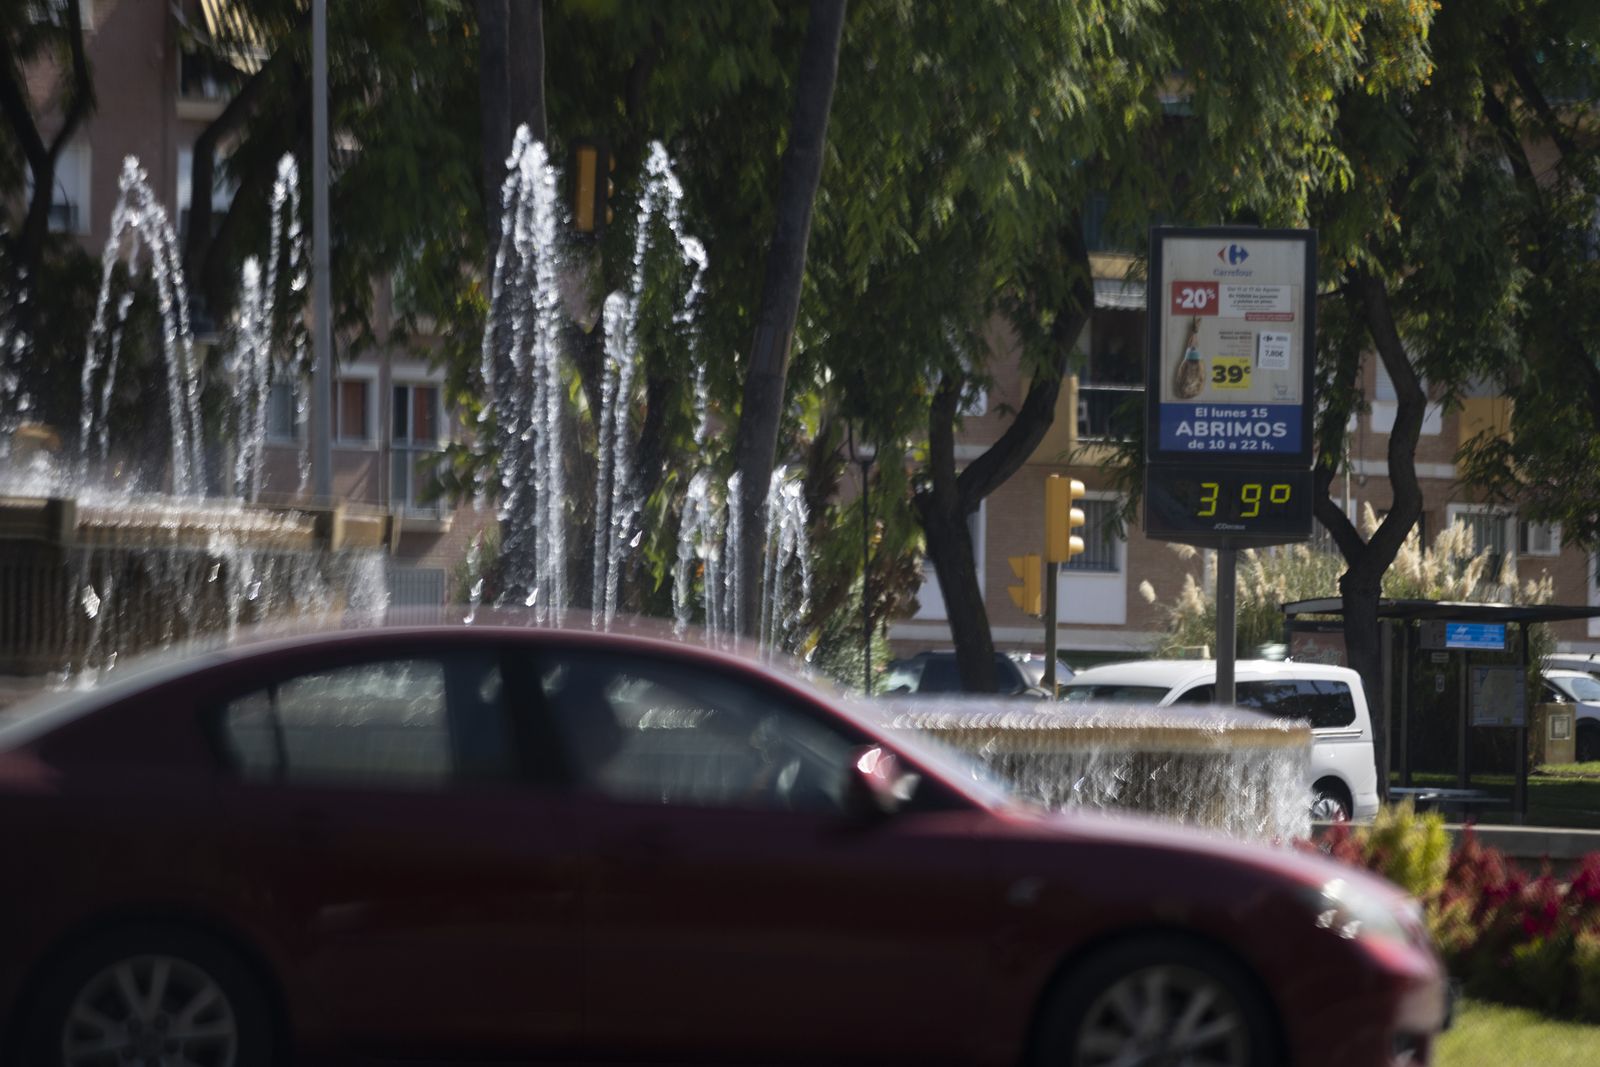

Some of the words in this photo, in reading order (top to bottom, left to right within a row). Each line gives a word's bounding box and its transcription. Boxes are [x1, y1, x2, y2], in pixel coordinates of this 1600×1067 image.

[1175, 287, 1216, 309] -20%
[1195, 407, 1208, 418] El
[1211, 408, 1247, 419] lunes
[1251, 408, 1268, 419] 15
[1175, 421, 1288, 438] ABRIMOS
[1188, 440, 1205, 450] de
[1208, 440, 1226, 450] 10
[1241, 440, 1258, 450] 22
[1261, 440, 1275, 451] h.
